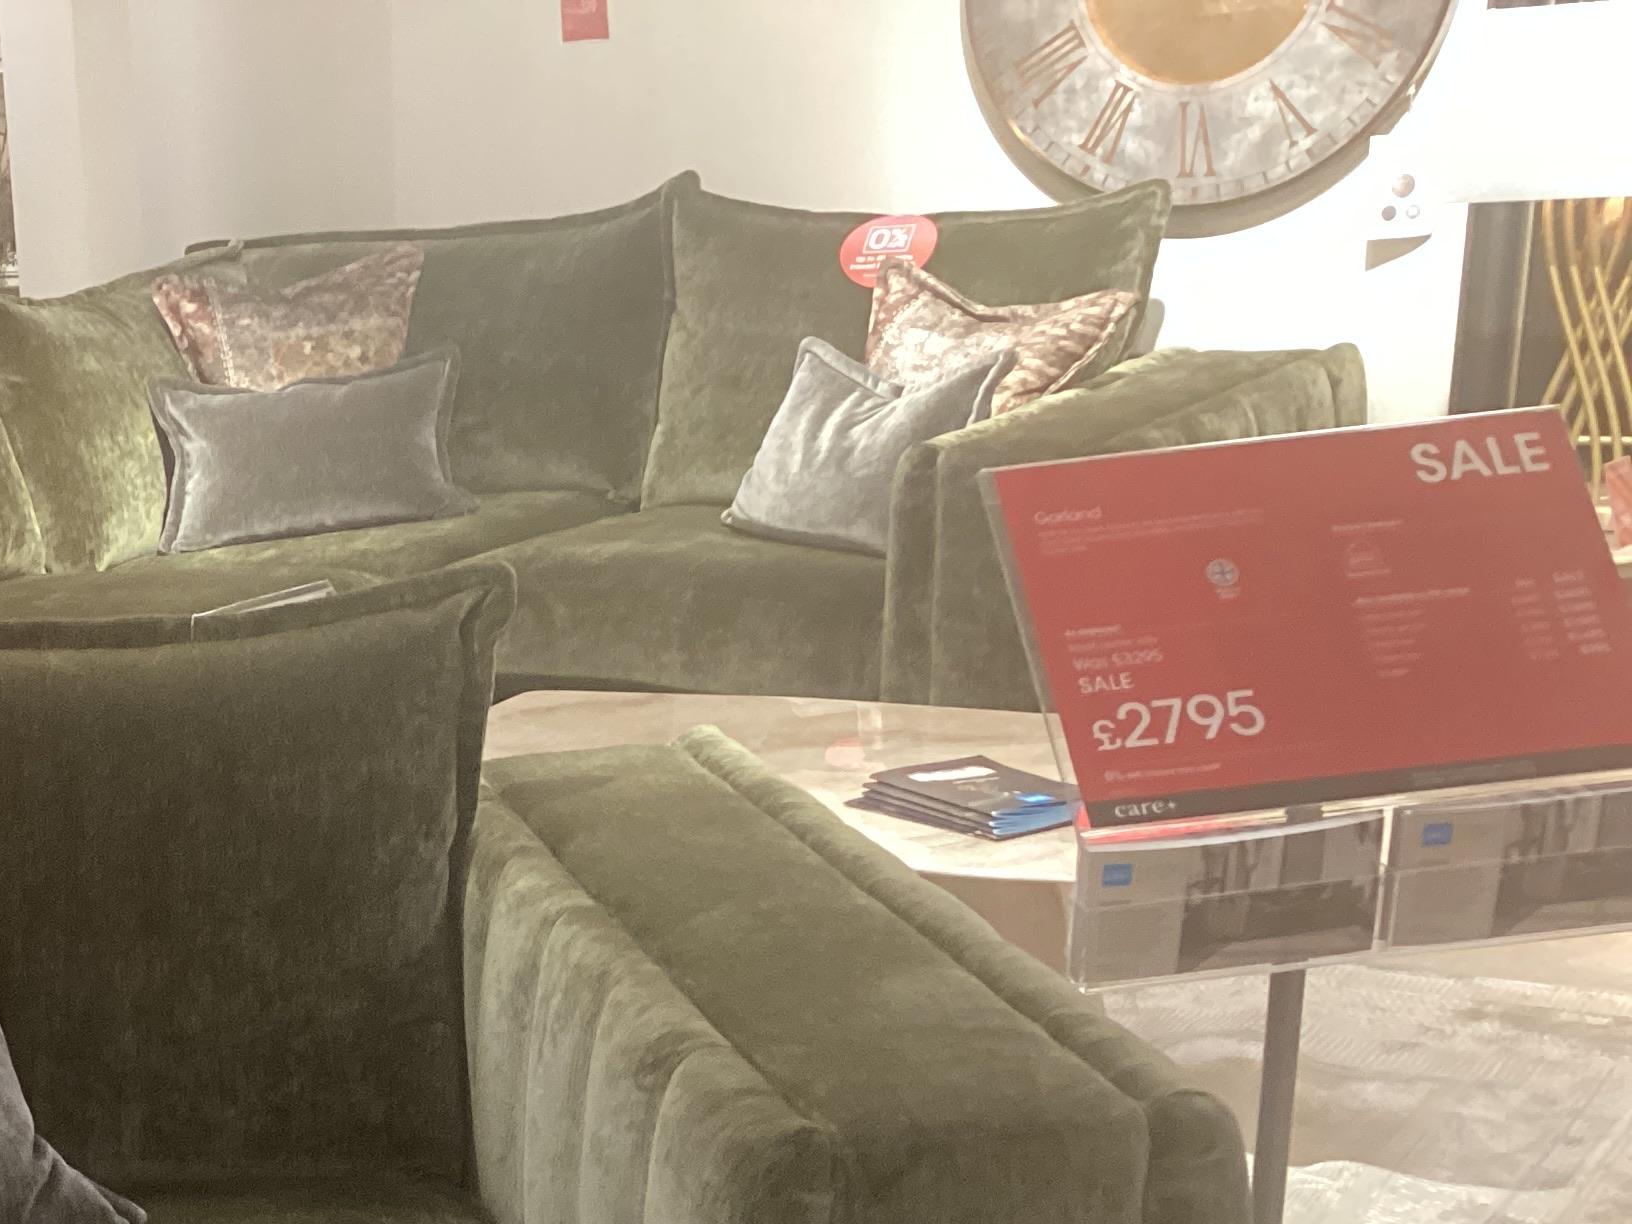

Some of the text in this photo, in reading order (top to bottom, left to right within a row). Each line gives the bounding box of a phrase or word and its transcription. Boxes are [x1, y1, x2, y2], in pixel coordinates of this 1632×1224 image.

[1409, 431, 1551, 484] SALE
[1077, 671, 1136, 694] SALE
[1091, 688, 1266, 752] £2795
